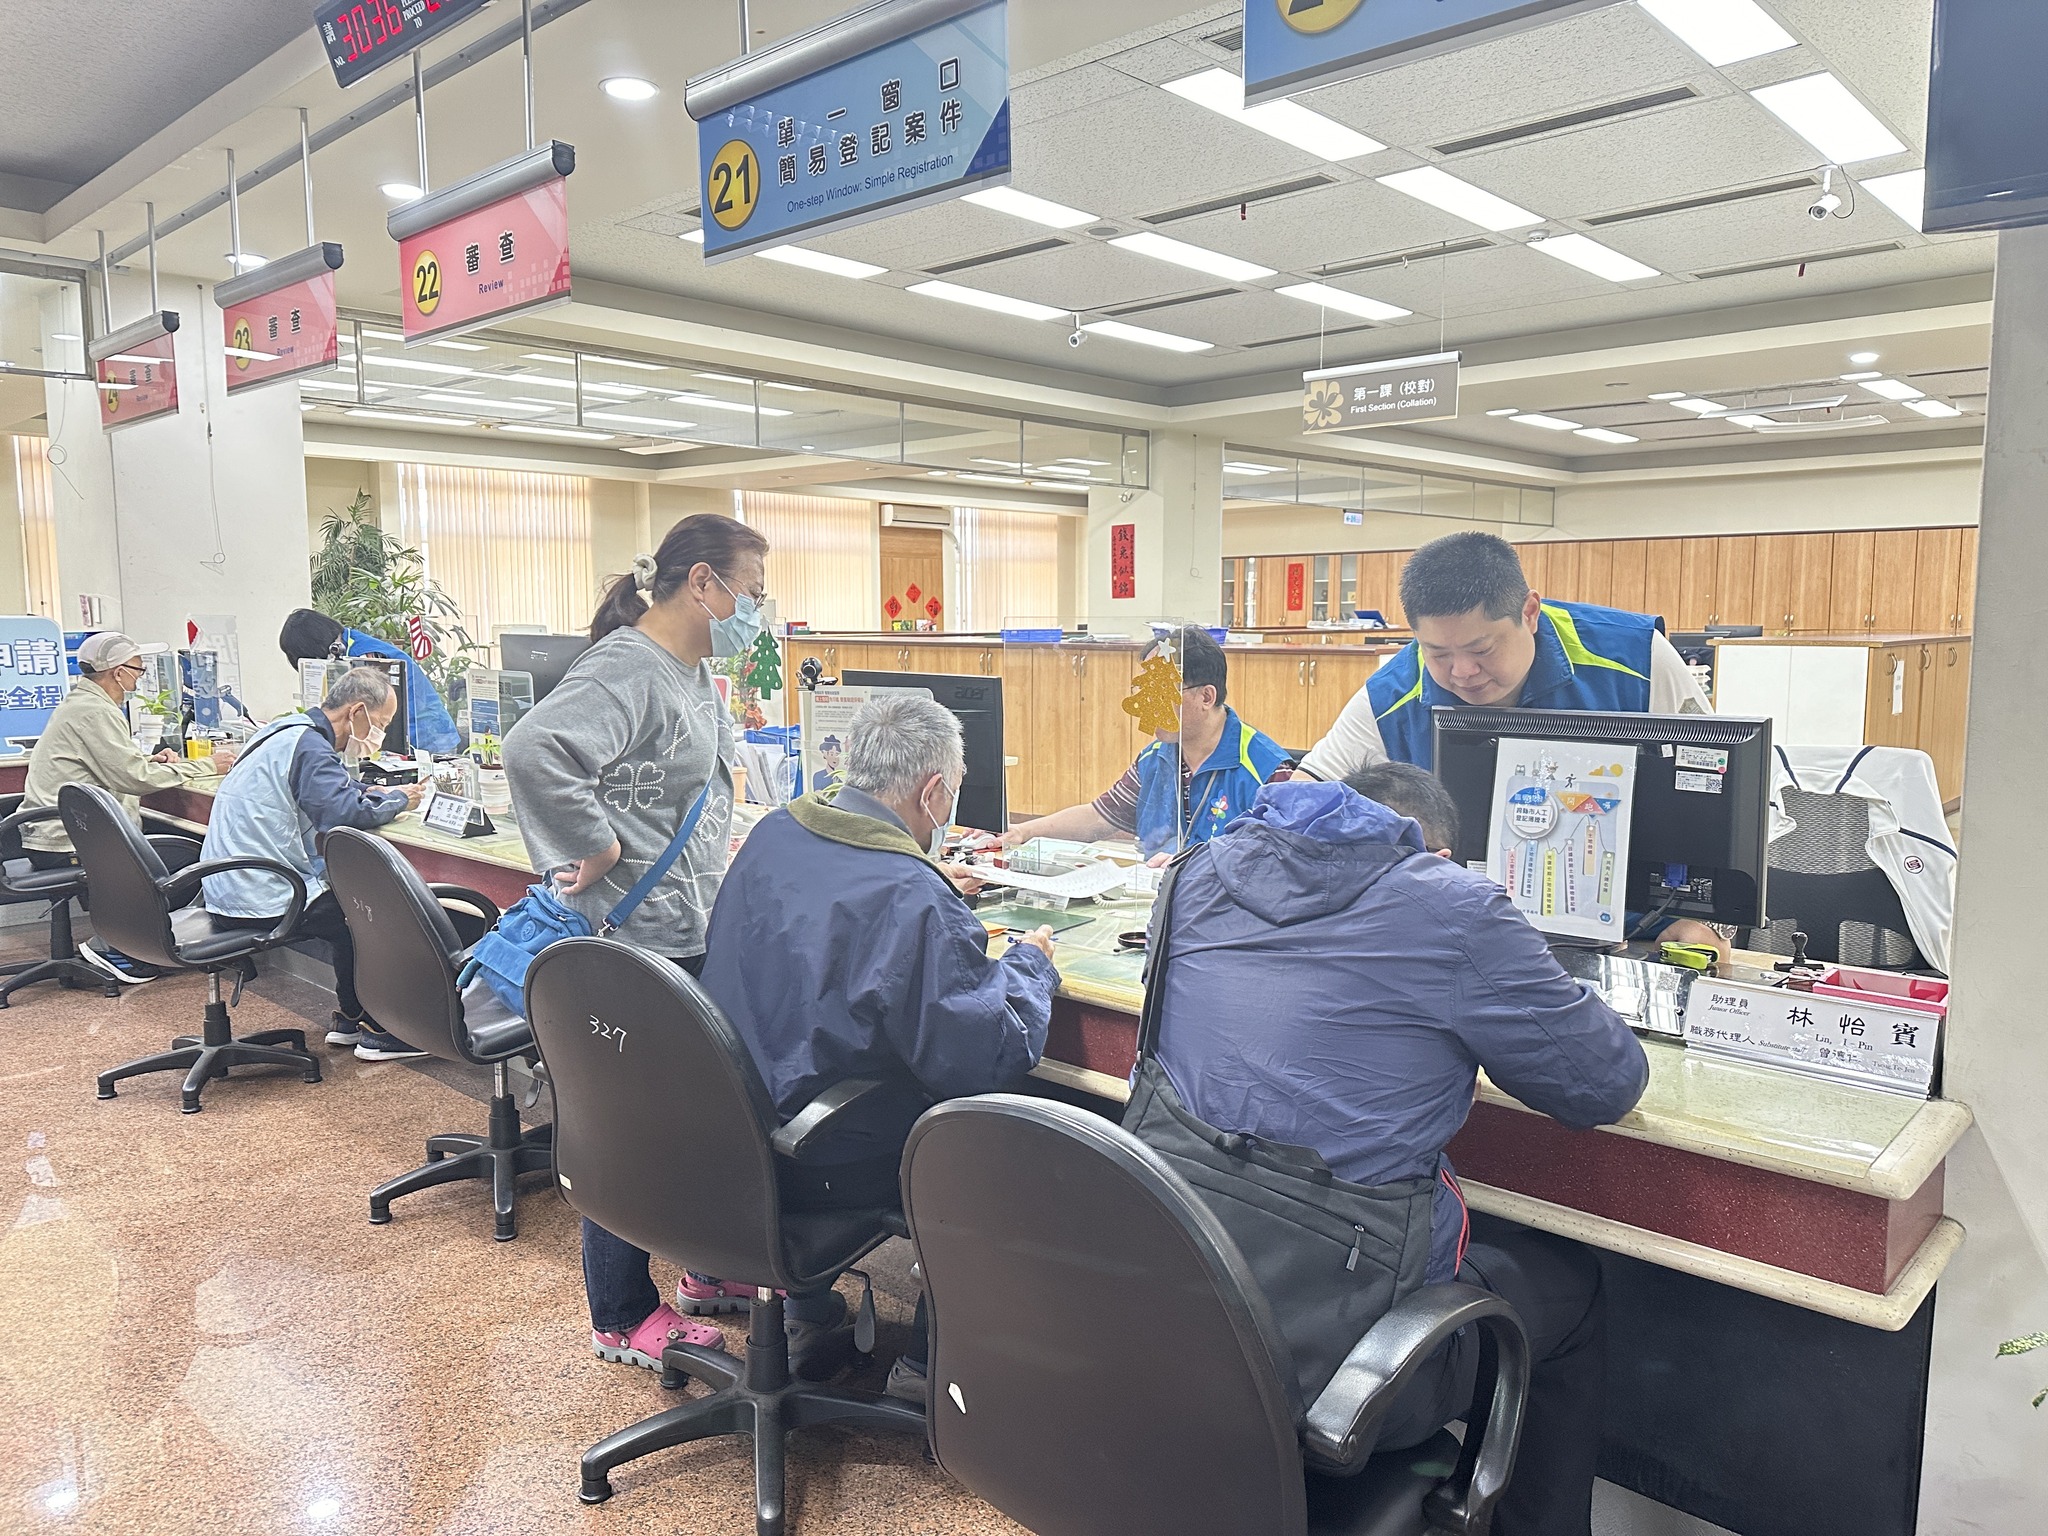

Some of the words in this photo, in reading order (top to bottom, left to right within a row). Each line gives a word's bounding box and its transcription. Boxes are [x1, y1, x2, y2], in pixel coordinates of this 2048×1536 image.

[402, 0, 426, 21] PROCEED
[337, 0, 403, 62] 3036
[413, 16, 423, 28] TO
[777, 58, 960, 148] 單一窗口
[778, 99, 962, 187] 簡易登記案件
[713, 154, 751, 214] 21
[787, 193, 824, 214] One-step
[825, 180, 862, 201] Window:
[864, 169, 895, 191] Simple
[897, 153, 954, 181] Registration
[465, 230, 515, 275] 審查
[416, 261, 439, 304] 22
[478, 279, 504, 295] Review
[1350, 405, 1368, 414] First
[1368, 401, 1396, 413] Section
[1397, 396, 1437, 410] (Collation)
[1708, 1004, 1728, 1014] Junior
[1729, 1007, 1751, 1017] Officer
[1711, 993, 1749, 1009] 助理員
[589, 1014, 628, 1053] 327
[1690, 1024, 1756, 1045] 職務代理人
[1815, 1033, 1832, 1045] Lin,
[1758, 1040, 1790, 1052] Substitute
